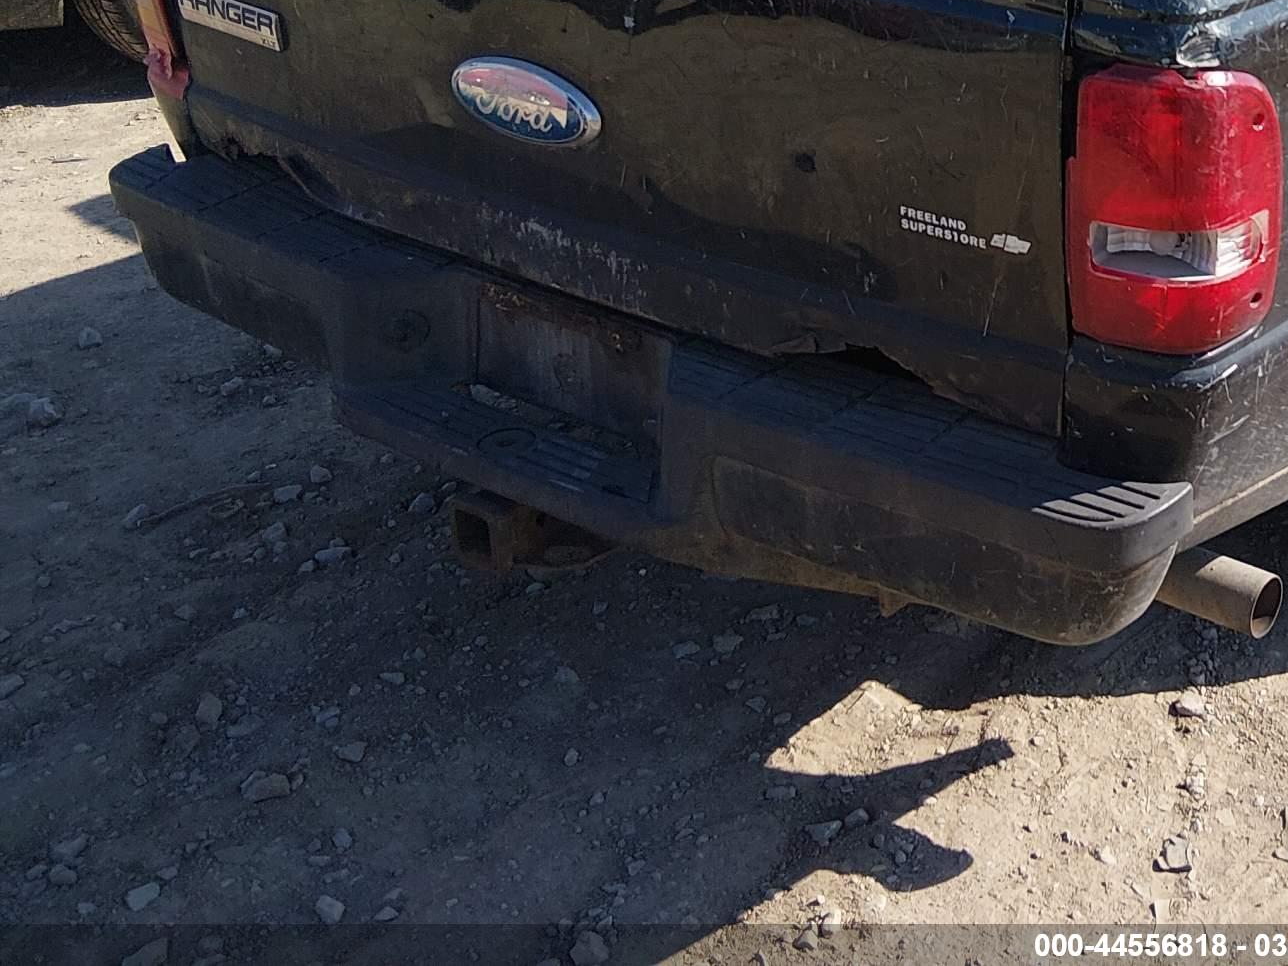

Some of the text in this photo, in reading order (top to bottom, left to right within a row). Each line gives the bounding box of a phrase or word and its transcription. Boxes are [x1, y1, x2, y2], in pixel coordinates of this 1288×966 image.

[260, 37, 277, 49] XLT
[475, 90, 553, 133] Ford
[900, 205, 967, 232] FREELAND
[900, 218, 987, 250] SUPERSTORE
